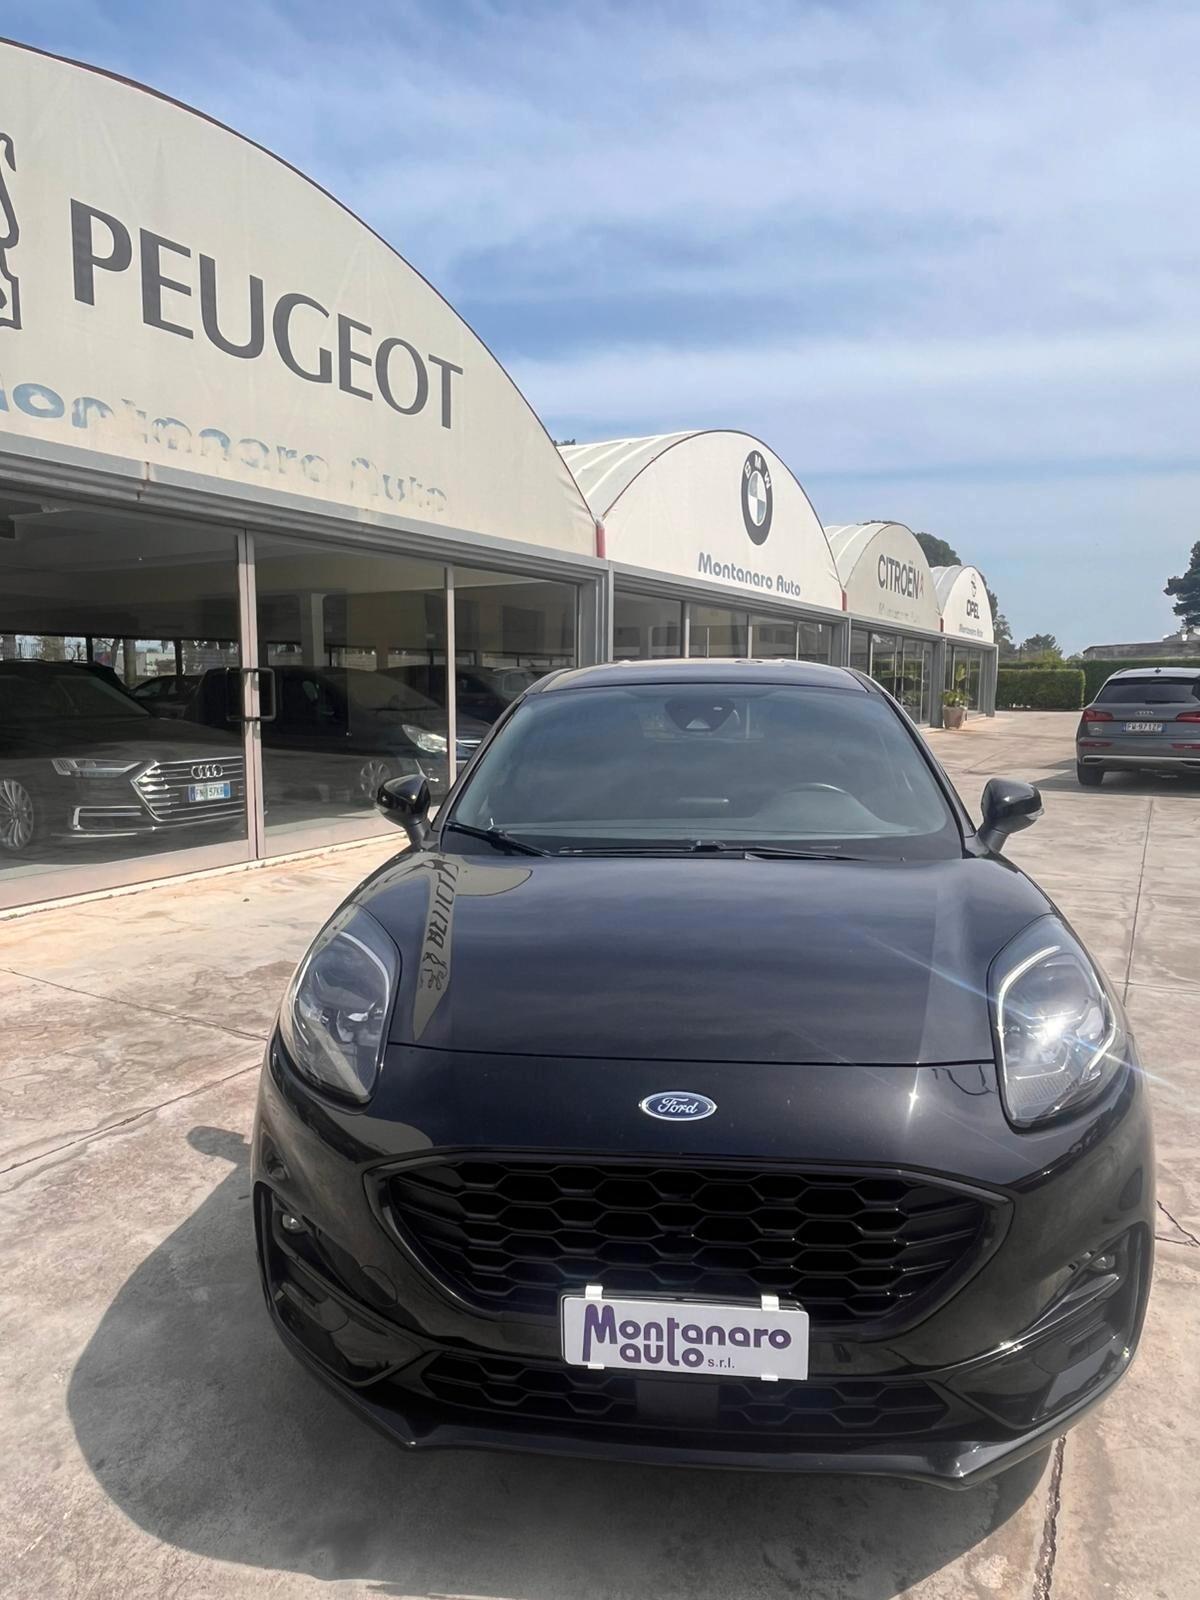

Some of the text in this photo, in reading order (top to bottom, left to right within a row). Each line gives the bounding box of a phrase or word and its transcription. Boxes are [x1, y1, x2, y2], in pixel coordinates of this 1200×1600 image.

[71, 198, 463, 429] PEUGEOT
[744, 454, 772, 489] BMW
[698, 552, 801, 596] Montanaro Auto
[878, 554, 920, 600] CITROËN
[966, 599, 980, 619] OPEL
[658, 1097, 699, 1113] Ford
[582, 1303, 792, 1362] Montanaro
[620, 1341, 735, 1369] auto s.r.l.
